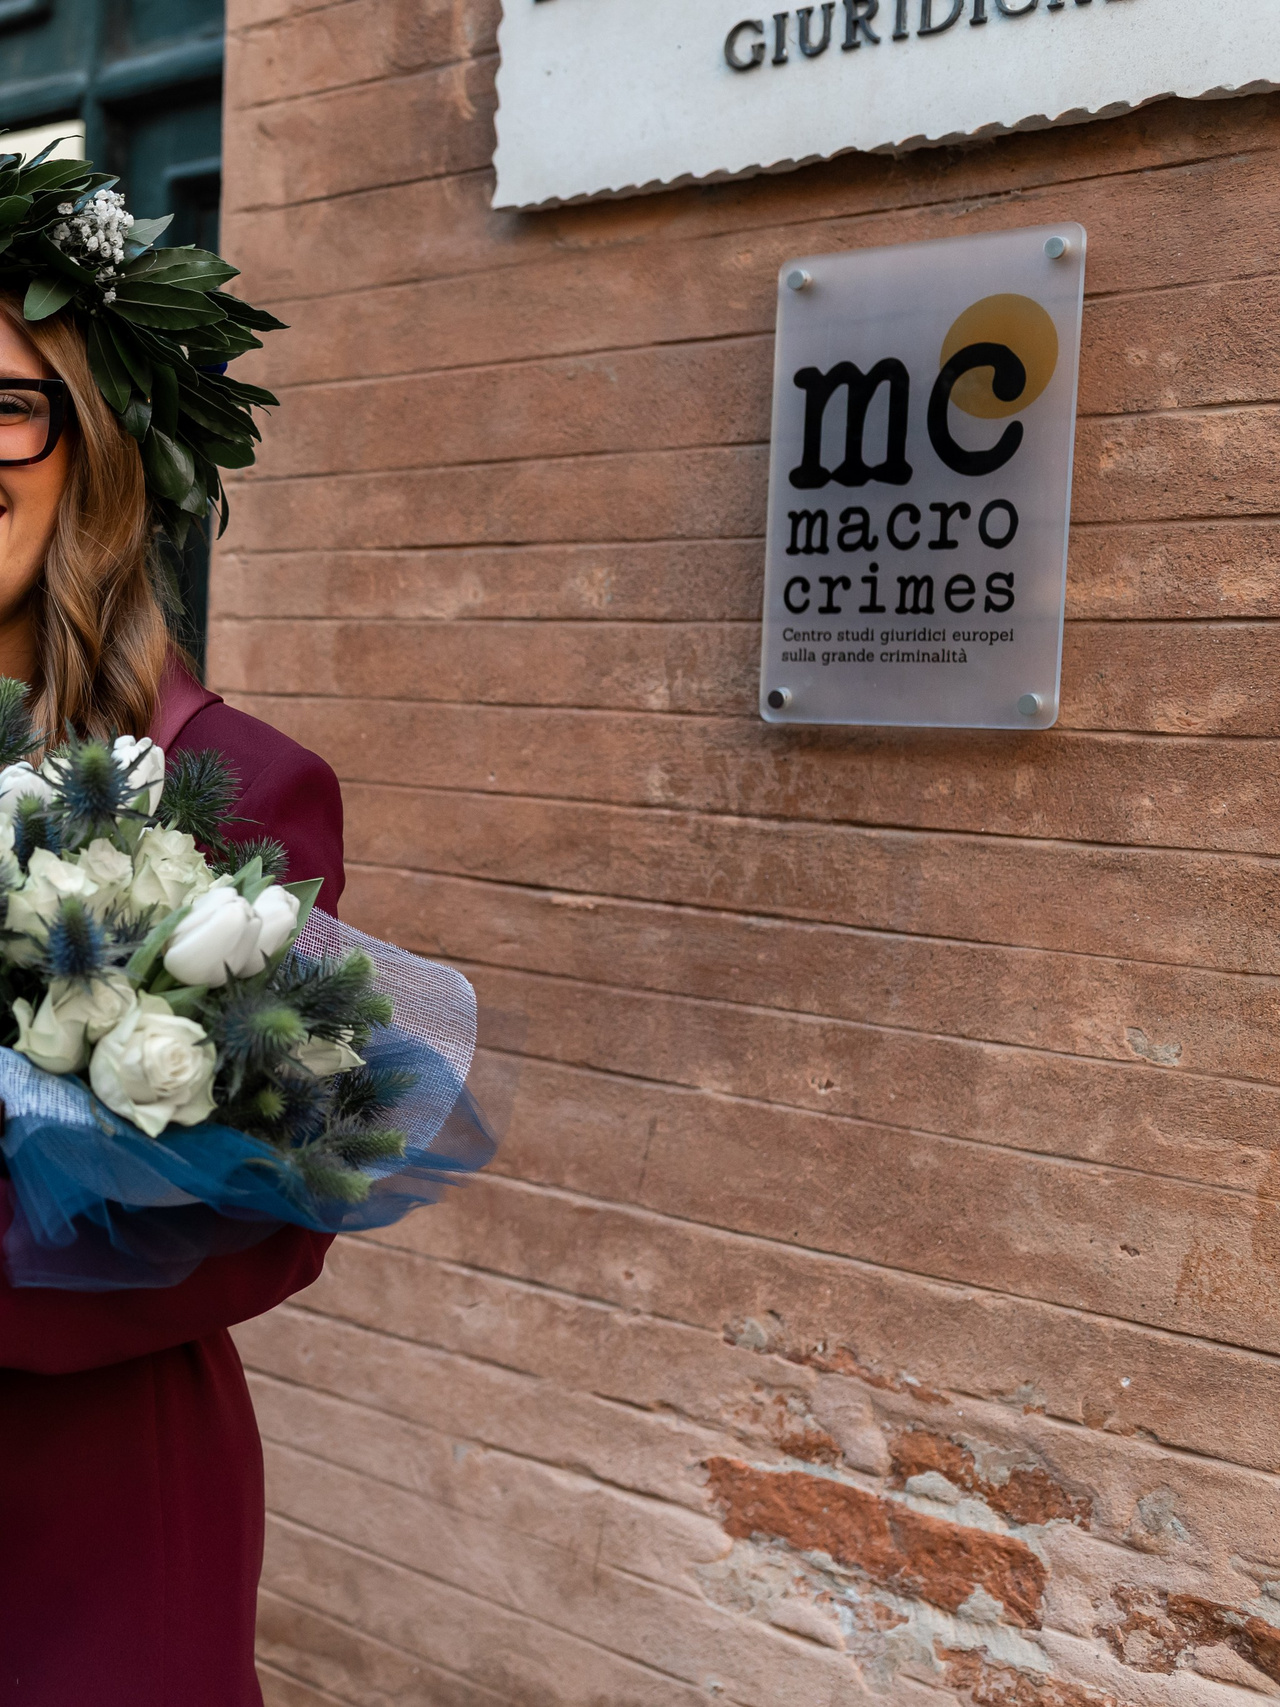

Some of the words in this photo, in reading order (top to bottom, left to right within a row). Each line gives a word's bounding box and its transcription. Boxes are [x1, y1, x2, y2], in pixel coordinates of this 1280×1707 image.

[724, 0, 1132, 72] GIURIDI
[788, 341, 1026, 490] mc
[785, 498, 1019, 556] macro
[783, 562, 1015, 615] crimes
[781, 648, 816, 663] sulla
[821, 649, 875, 666] grande
[880, 648, 968, 663] criminalità
[782, 627, 832, 642] Centro
[837, 627, 875, 642] studi
[880, 627, 946, 646] giuridici
[952, 628, 1014, 646] europei
